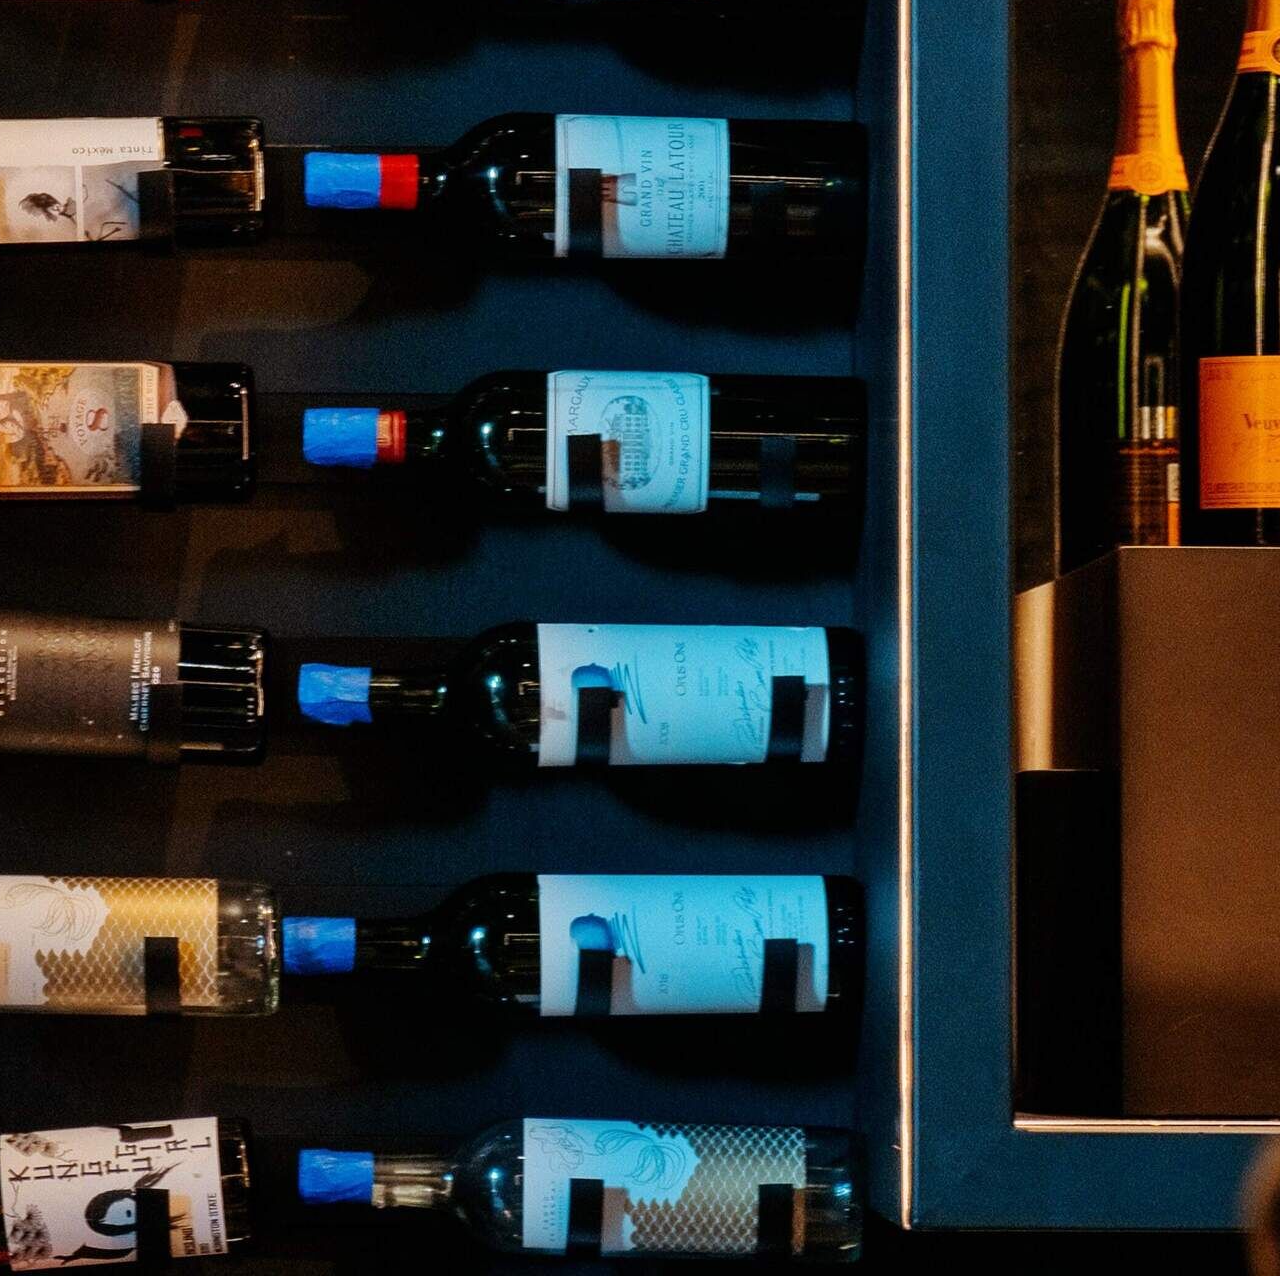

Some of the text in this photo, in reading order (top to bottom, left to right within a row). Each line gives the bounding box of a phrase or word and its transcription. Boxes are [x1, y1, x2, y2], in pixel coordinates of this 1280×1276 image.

[120, 145, 153, 155] Tinta
[668, 123, 686, 181] LATOUR
[639, 149, 653, 228] GRAND VIN
[69, 397, 89, 447] VOYAGE
[84, 408, 110, 433] 8
[678, 409, 690, 431] CRU
[128, 638, 142, 722] MALBEC MERLOT
[139, 631, 153, 732] CABERNET SAUVIGNON
[115, 1137, 212, 1157] GIRL
